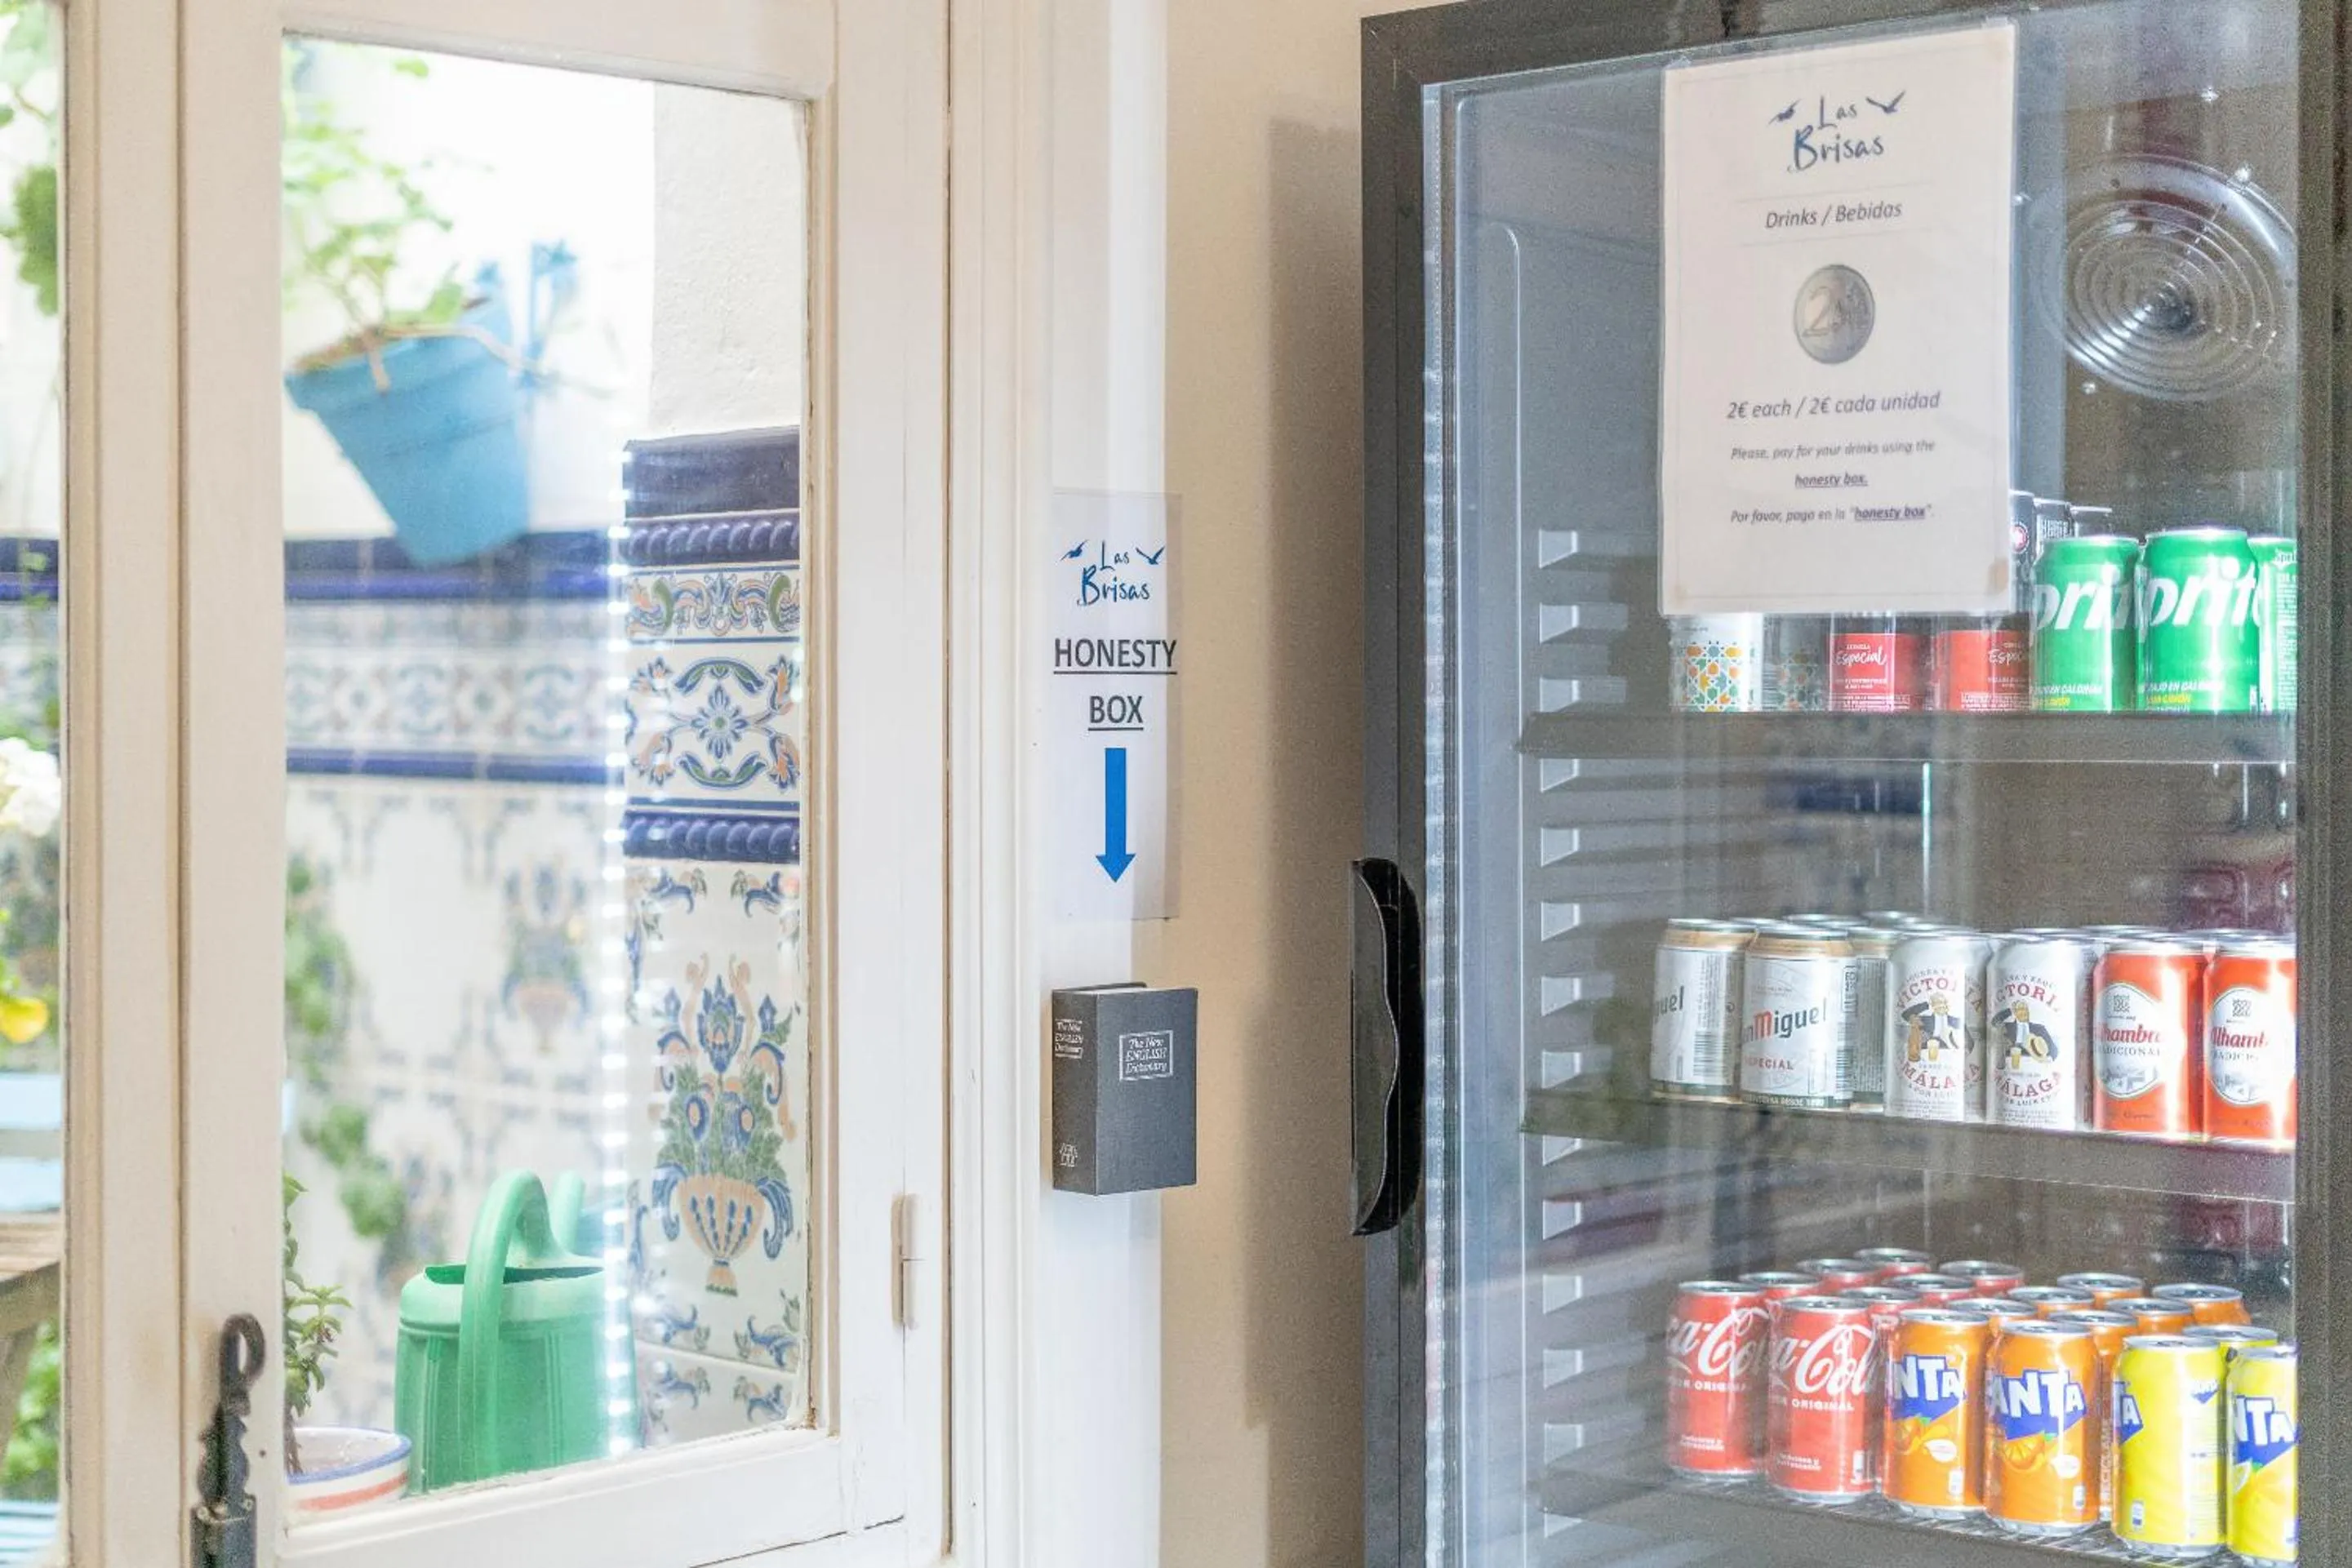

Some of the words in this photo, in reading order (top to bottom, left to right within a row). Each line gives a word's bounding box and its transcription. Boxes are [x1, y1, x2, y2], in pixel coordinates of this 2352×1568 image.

[1817, 96, 1857, 130] Las
[1788, 124, 1885, 174] Brisas
[1765, 205, 1817, 229] Drinks
[1821, 204, 1830, 227] /
[1835, 201, 1903, 224] Bebidas
[1727, 402, 1747, 420] 2€
[1752, 399, 1791, 418] each
[1795, 398, 1805, 419] /
[1808, 397, 1831, 415] 2€
[1835, 394, 1876, 414] cada
[1881, 391, 1941, 411] unidad
[1772, 449, 1793, 461] pay
[1796, 445, 1812, 460] for
[1816, 446, 1839, 460] your
[1844, 440, 1878, 455] drinks
[1882, 442, 1913, 455] using
[1916, 438, 1936, 452] the
[1795, 473, 1839, 488] honesty
[1731, 509, 1749, 523] Por
[1752, 509, 1782, 526] favor,
[1818, 511, 1833, 522] en
[1834, 508, 1846, 520] la
[1100, 540, 1130, 571] Las
[1076, 565, 1150, 607] Brisas
[1054, 638, 1177, 669] HONESTY
[1835, 646, 1887, 667] Especial
[1089, 695, 1143, 724] BOX
[1791, 1398, 1855, 1411] ORIGINAL
